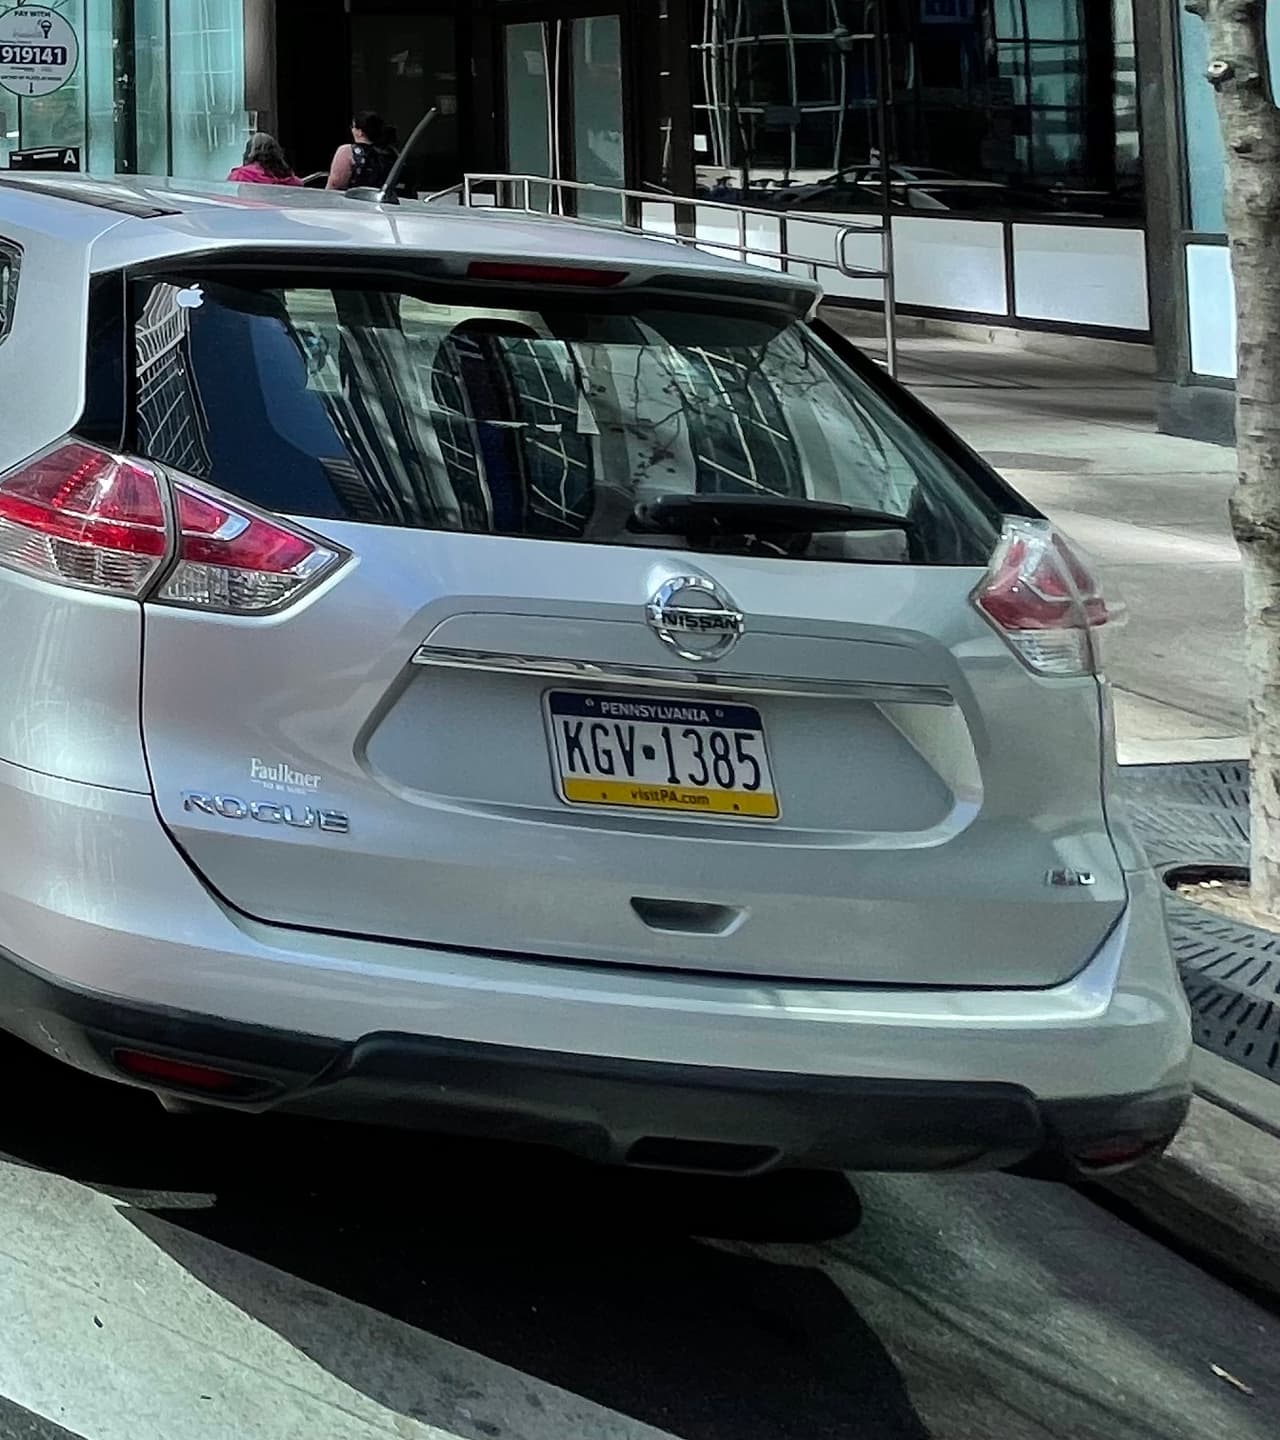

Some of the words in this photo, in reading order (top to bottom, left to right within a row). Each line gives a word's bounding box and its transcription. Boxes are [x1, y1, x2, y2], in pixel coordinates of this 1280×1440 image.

[1, 46, 62, 64] 919141
[662, 612, 738, 629] NISSAN
[600, 701, 710, 723] PENNSYLVANIA
[251, 757, 321, 788] Faulkner
[630, 789, 710, 806] visitPA.com
[181, 790, 350, 834] ROGUE
